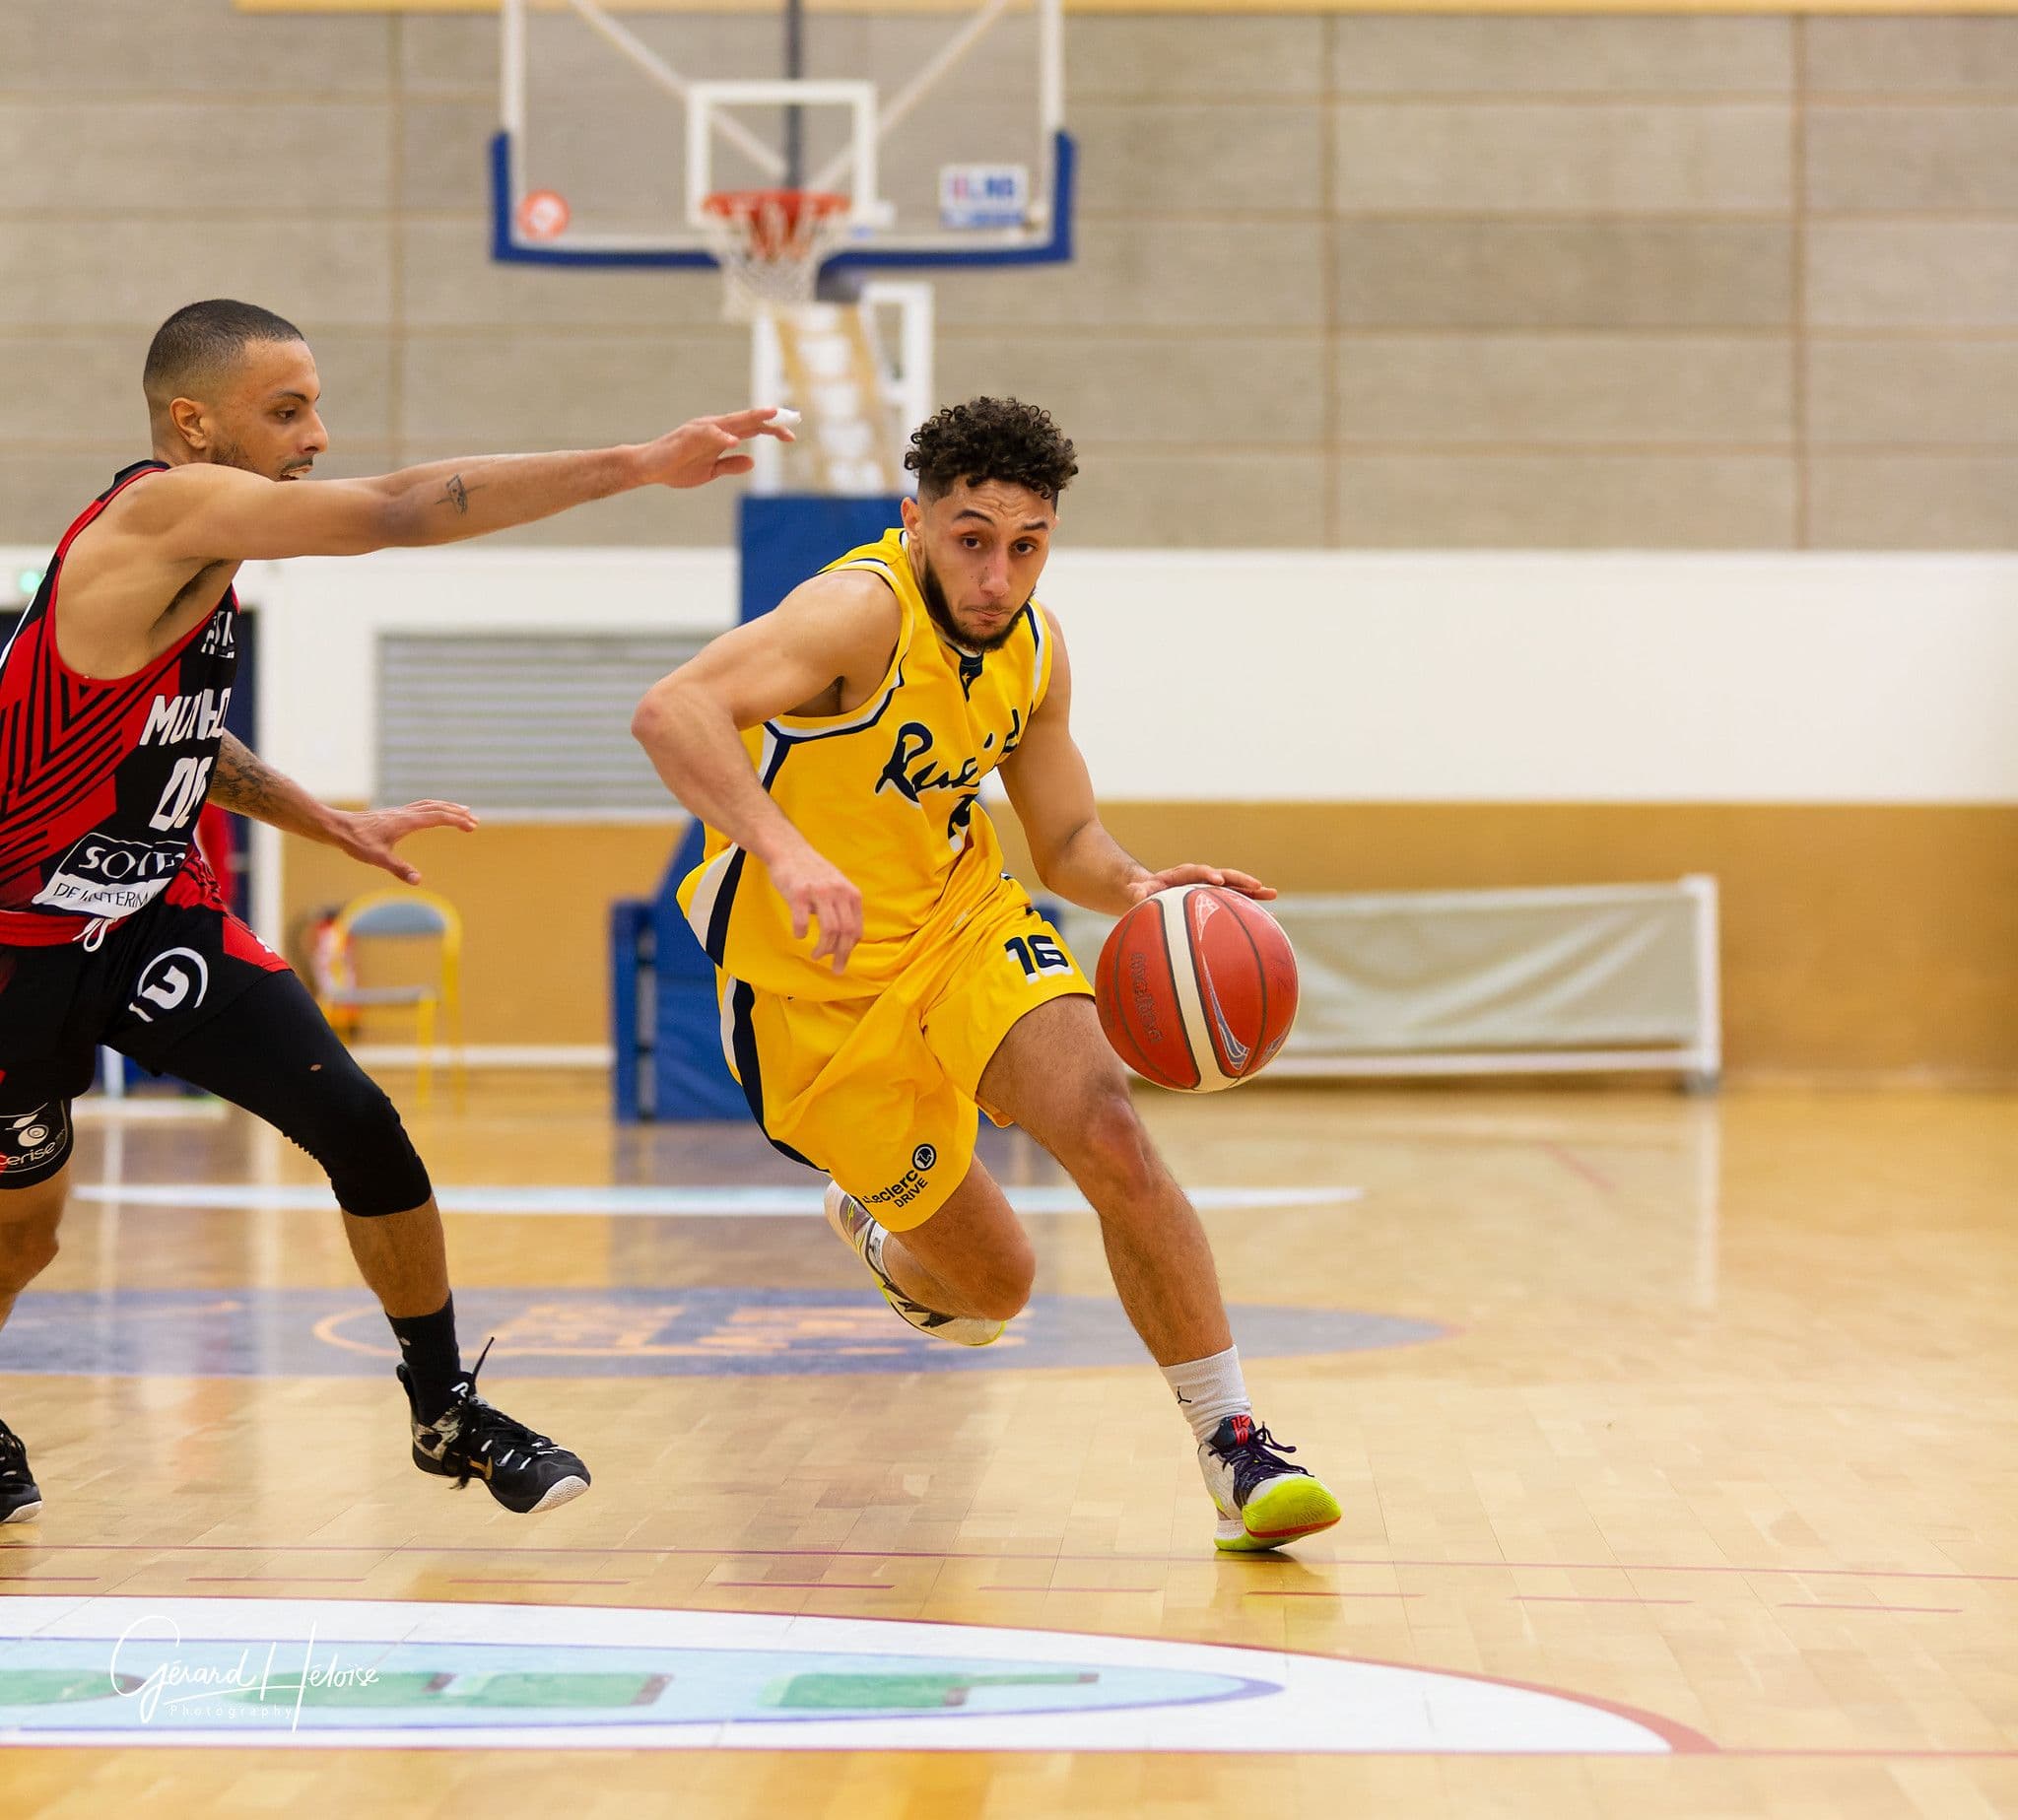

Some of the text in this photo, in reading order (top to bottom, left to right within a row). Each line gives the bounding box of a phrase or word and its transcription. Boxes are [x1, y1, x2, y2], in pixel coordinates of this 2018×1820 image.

[1003, 934, 1071, 982] 16
[0, 1141, 56, 1167] cerise
[894, 1177, 928, 1208] DRIVE
